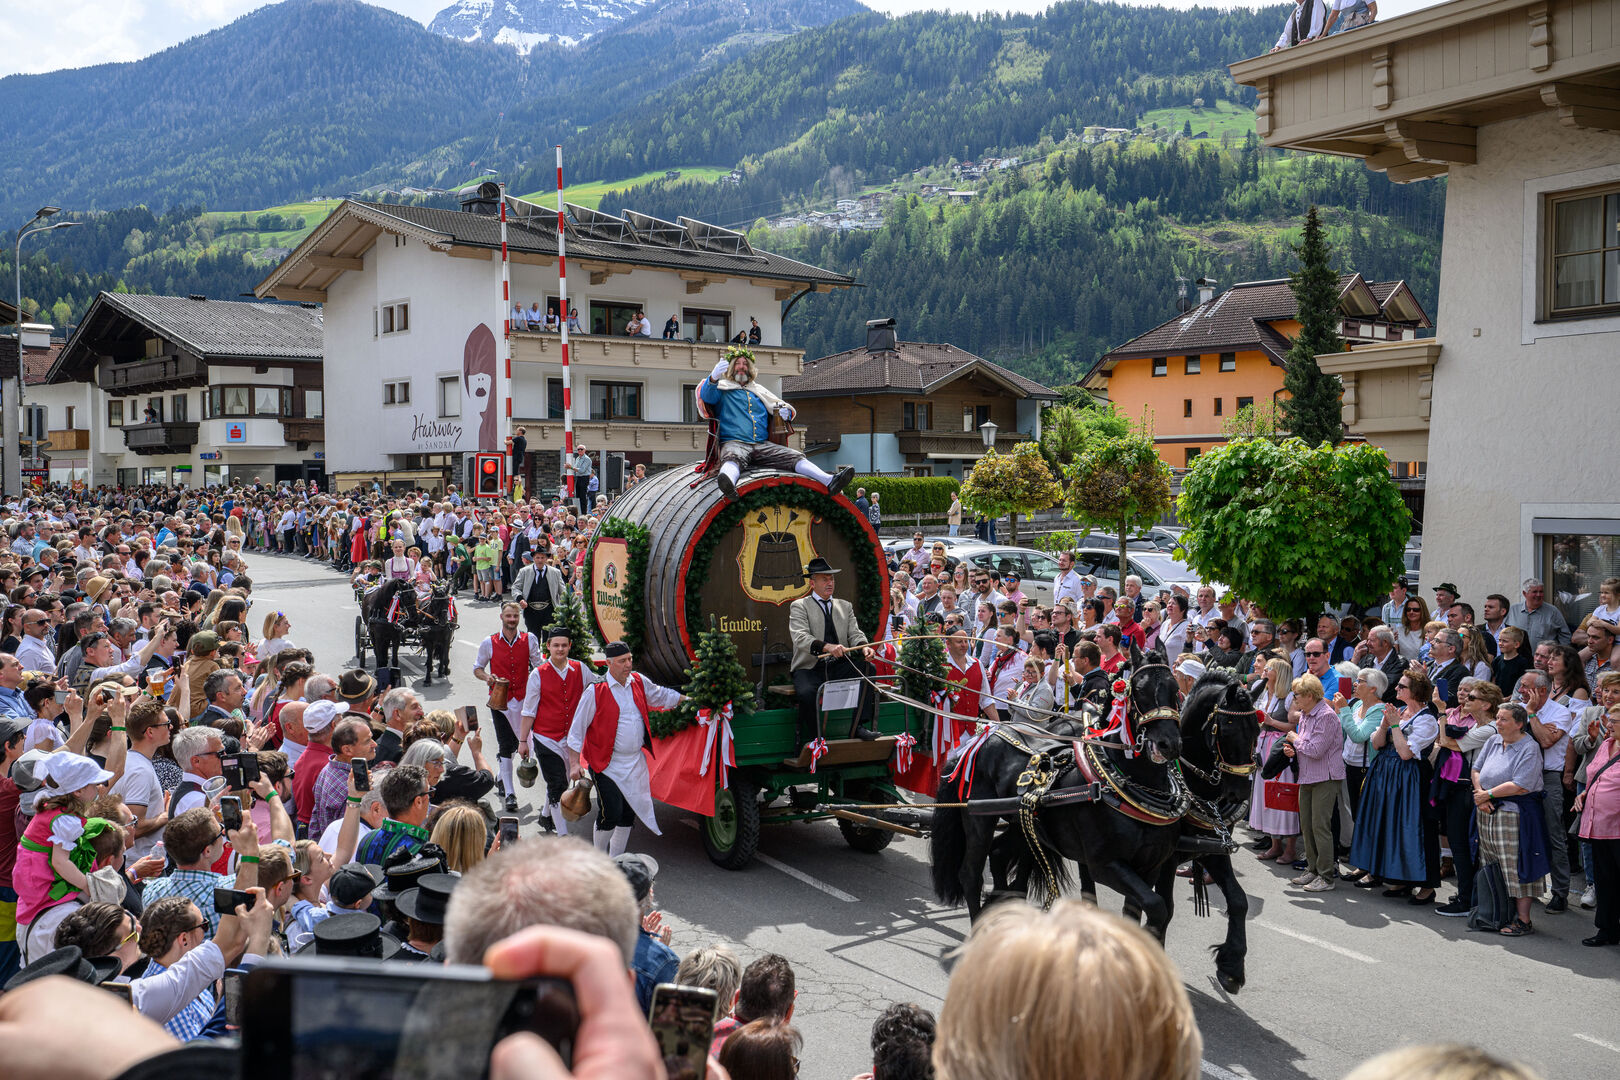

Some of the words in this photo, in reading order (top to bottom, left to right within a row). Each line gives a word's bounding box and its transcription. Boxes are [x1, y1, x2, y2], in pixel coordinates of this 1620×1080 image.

[412, 413, 462, 449] Hairway
[425, 441, 452, 450] SANDRA
[720, 616, 762, 632] Gauder
